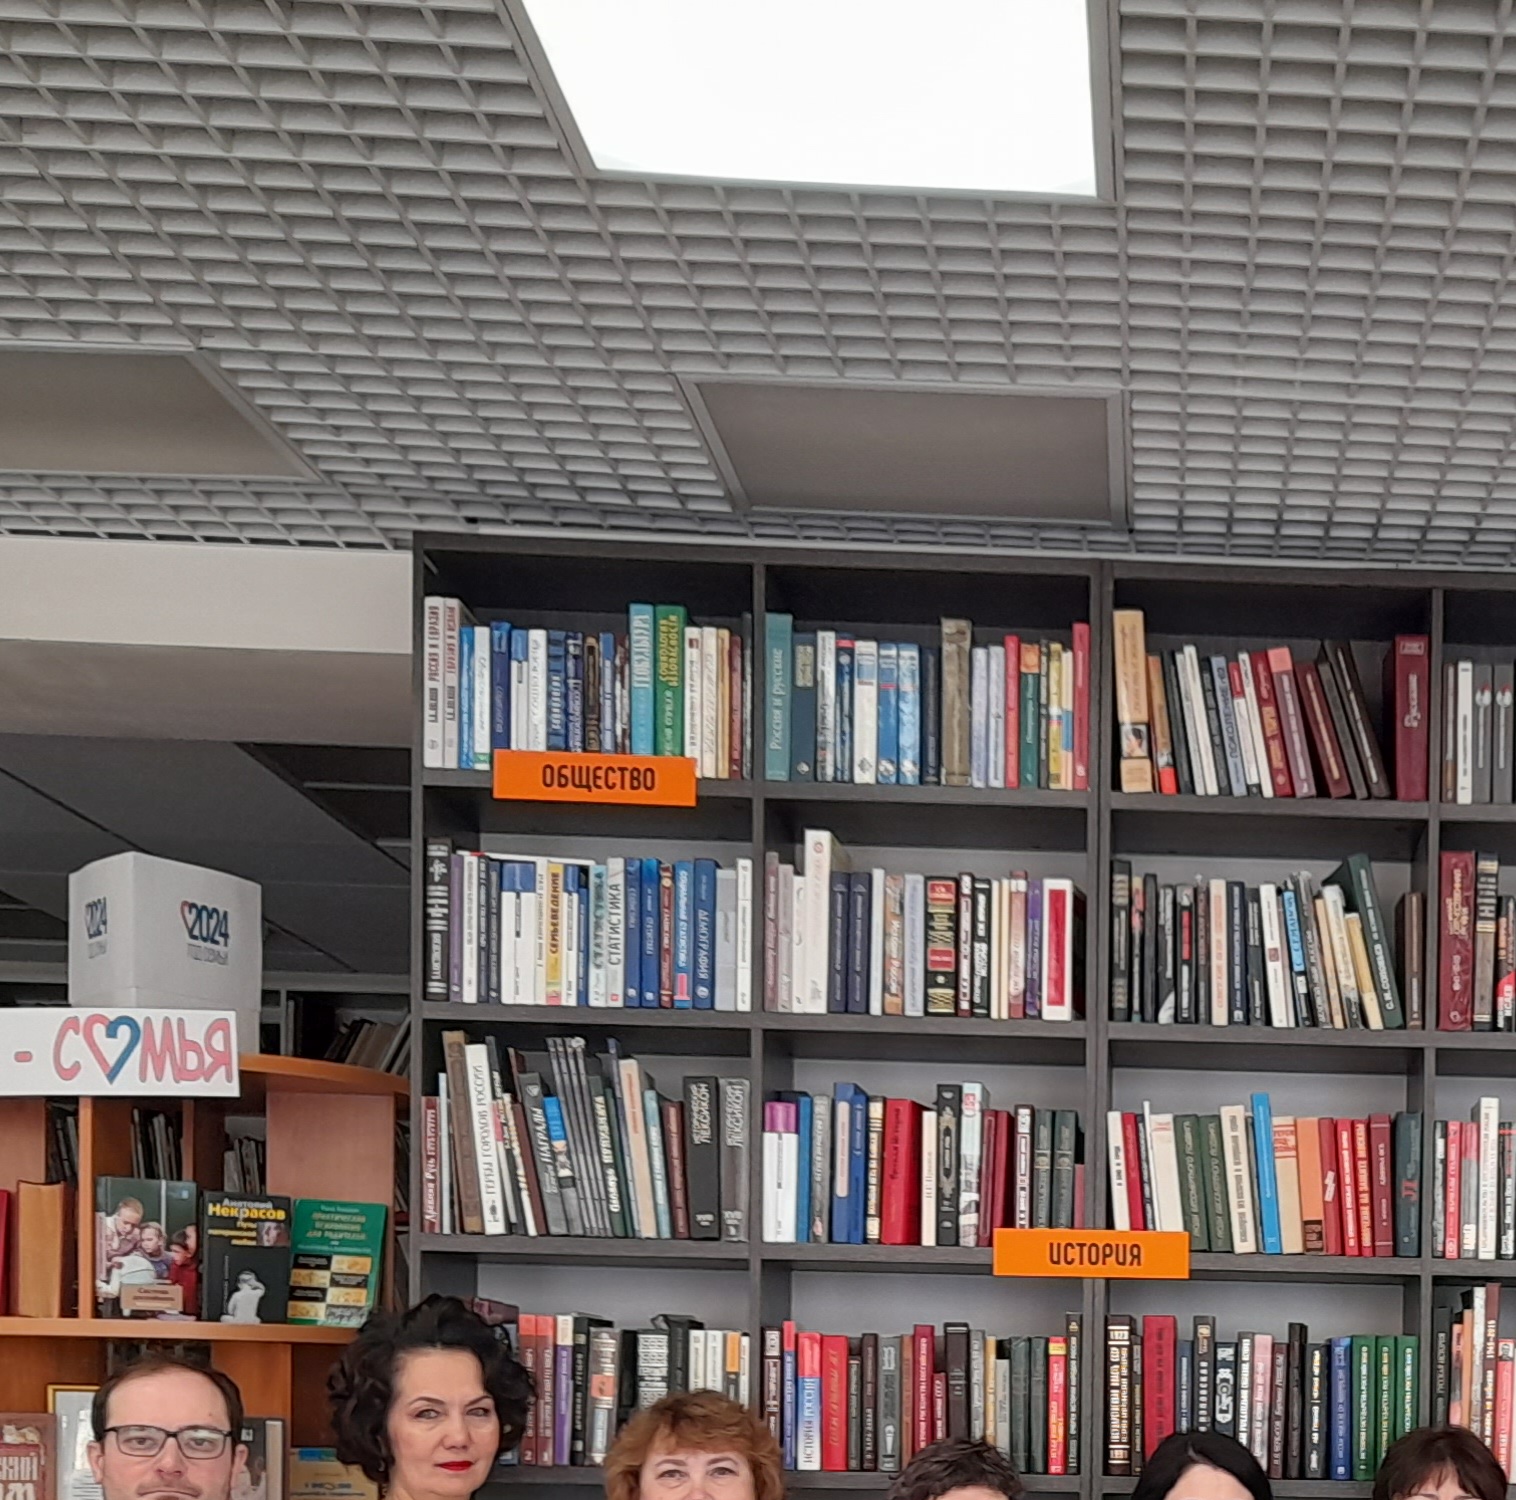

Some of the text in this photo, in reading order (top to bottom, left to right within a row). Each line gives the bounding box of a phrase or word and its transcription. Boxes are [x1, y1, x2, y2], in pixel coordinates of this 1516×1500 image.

[632, 614, 651, 688] ГЕОКУЛЬТУРА
[771, 647, 787, 695] русские
[768, 709, 784, 750] Россия
[543, 763, 655, 792] ОБЩЕСТВО
[85, 898, 107, 939] 2024
[188, 904, 229, 947] 2024
[549, 871, 561, 955] СЕМЬЕВЕДЕНИЕ
[591, 871, 605, 971] СТАТИСТИКА
[607, 883, 622, 967] СТАТИСТИКА
[677, 920, 689, 968] СТАТИСТИКА
[697, 908, 711, 980] ДЕМОГРАФИЯ
[1503, 983, 1513, 1017] ИСАЕВ
[471, 1064, 497, 1196] ГЕРБЫ ГОРОДОВ РОССИИ
[530, 1106, 553, 1163] НАГРАДЫ
[697, 1082, 714, 1144] ЛЕКСИКОН
[425, 1157, 436, 1180] Русь
[208, 1203, 287, 1221] Некрасов
[222, 1197, 273, 1210] Анатолий
[1049, 1242, 1142, 1266] ИСТОРИЯ
[803, 1377, 816, 1464] ИСТОРИЯ РОССИИ
